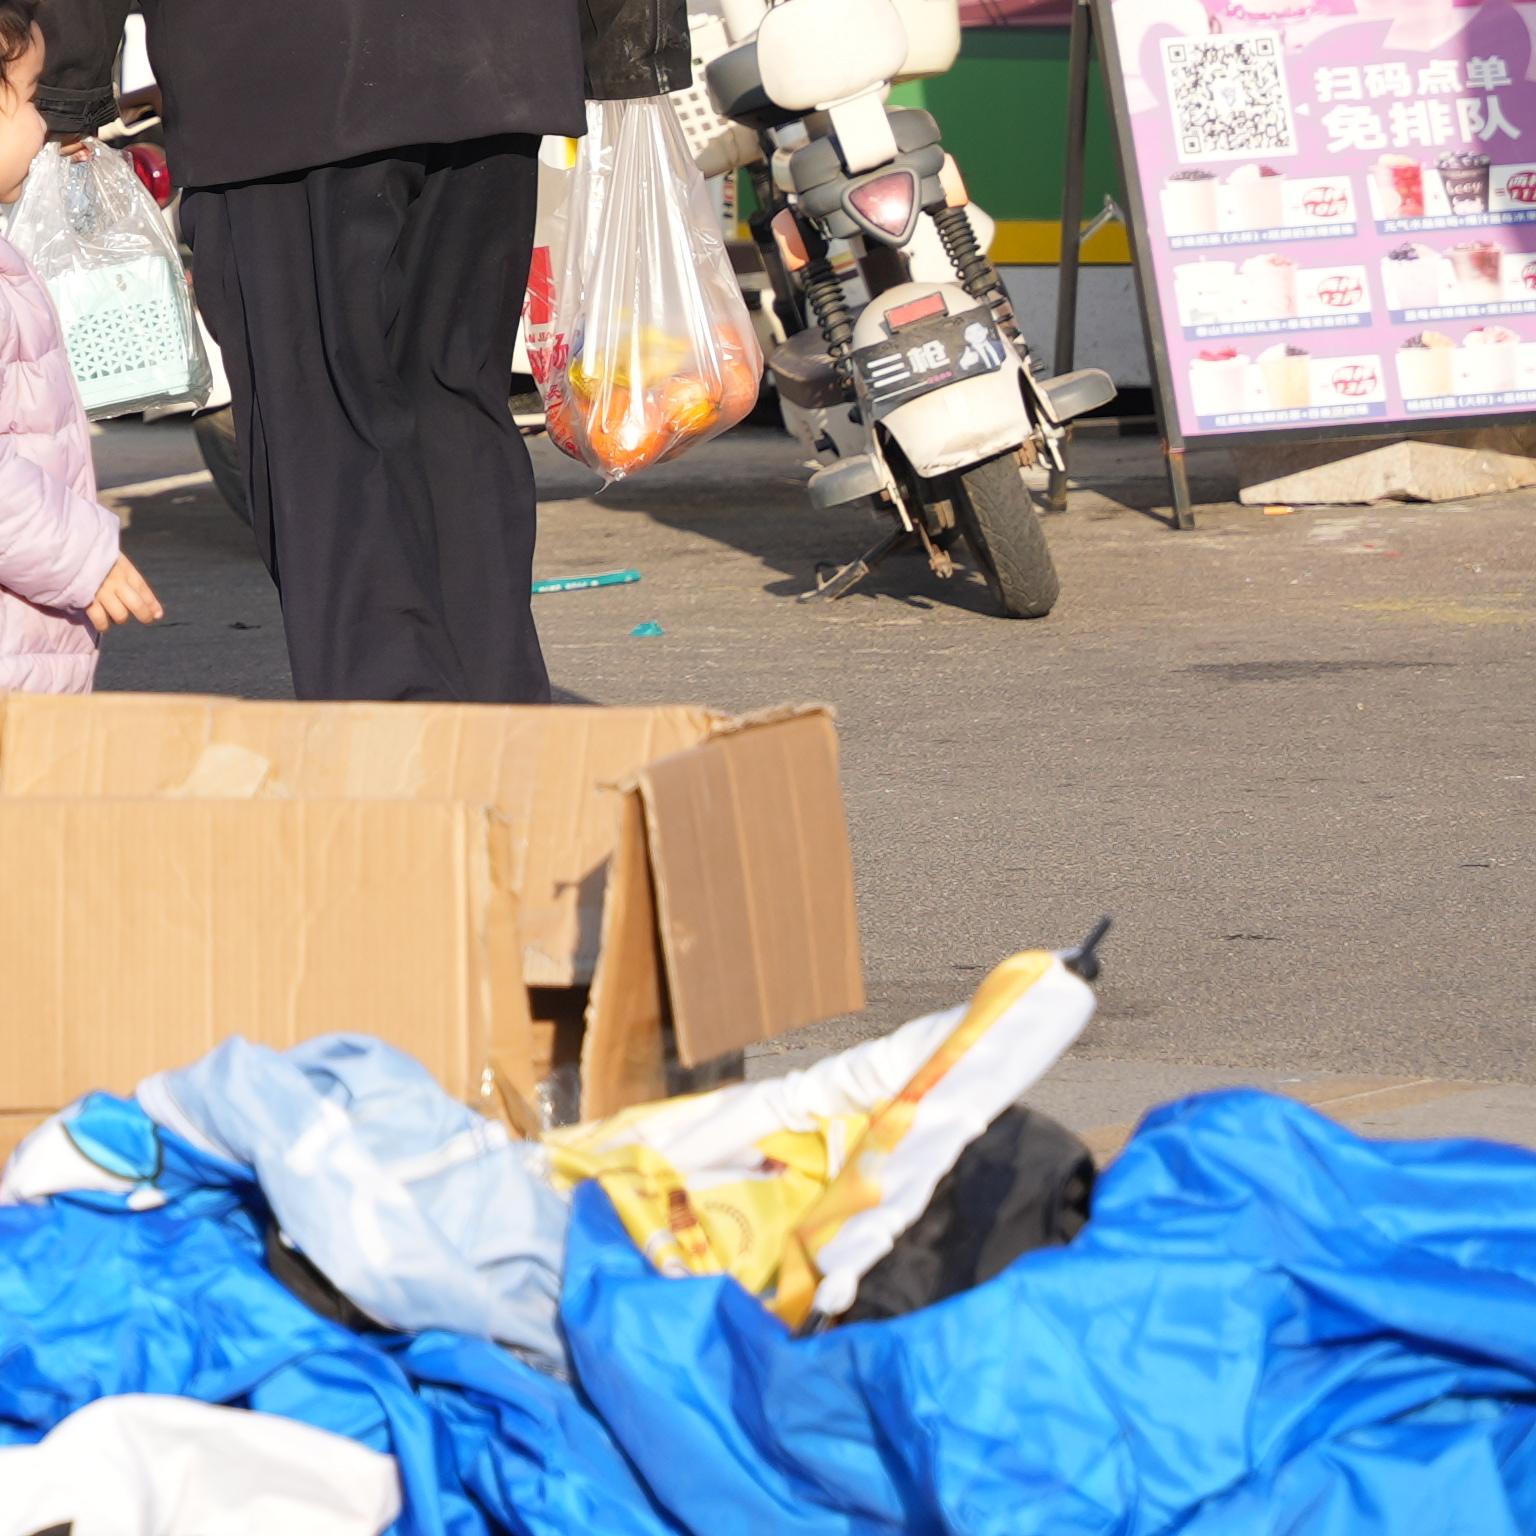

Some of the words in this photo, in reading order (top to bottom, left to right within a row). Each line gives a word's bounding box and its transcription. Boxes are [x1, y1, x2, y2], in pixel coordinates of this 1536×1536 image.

[1313, 55, 1512, 103] 扫码点单
[1321, 95, 1521, 153] 免排队
[866, 339, 951, 388] 三枪
